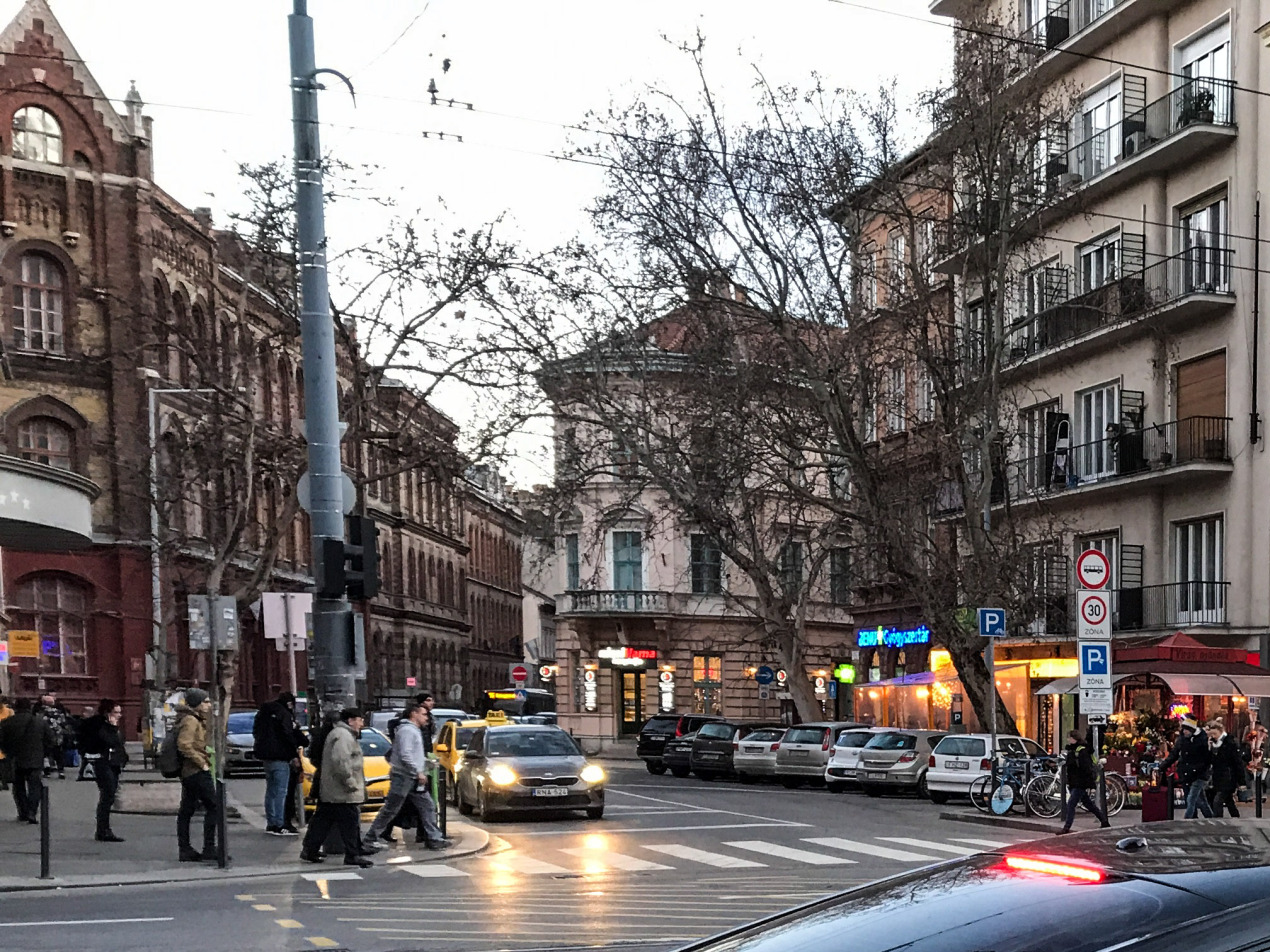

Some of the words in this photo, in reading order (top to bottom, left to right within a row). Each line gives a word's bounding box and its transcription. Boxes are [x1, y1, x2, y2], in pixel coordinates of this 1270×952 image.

[1088, 604, 1101, 617] 30
[985, 612, 1000, 633] P
[1087, 648, 1102, 671] P
